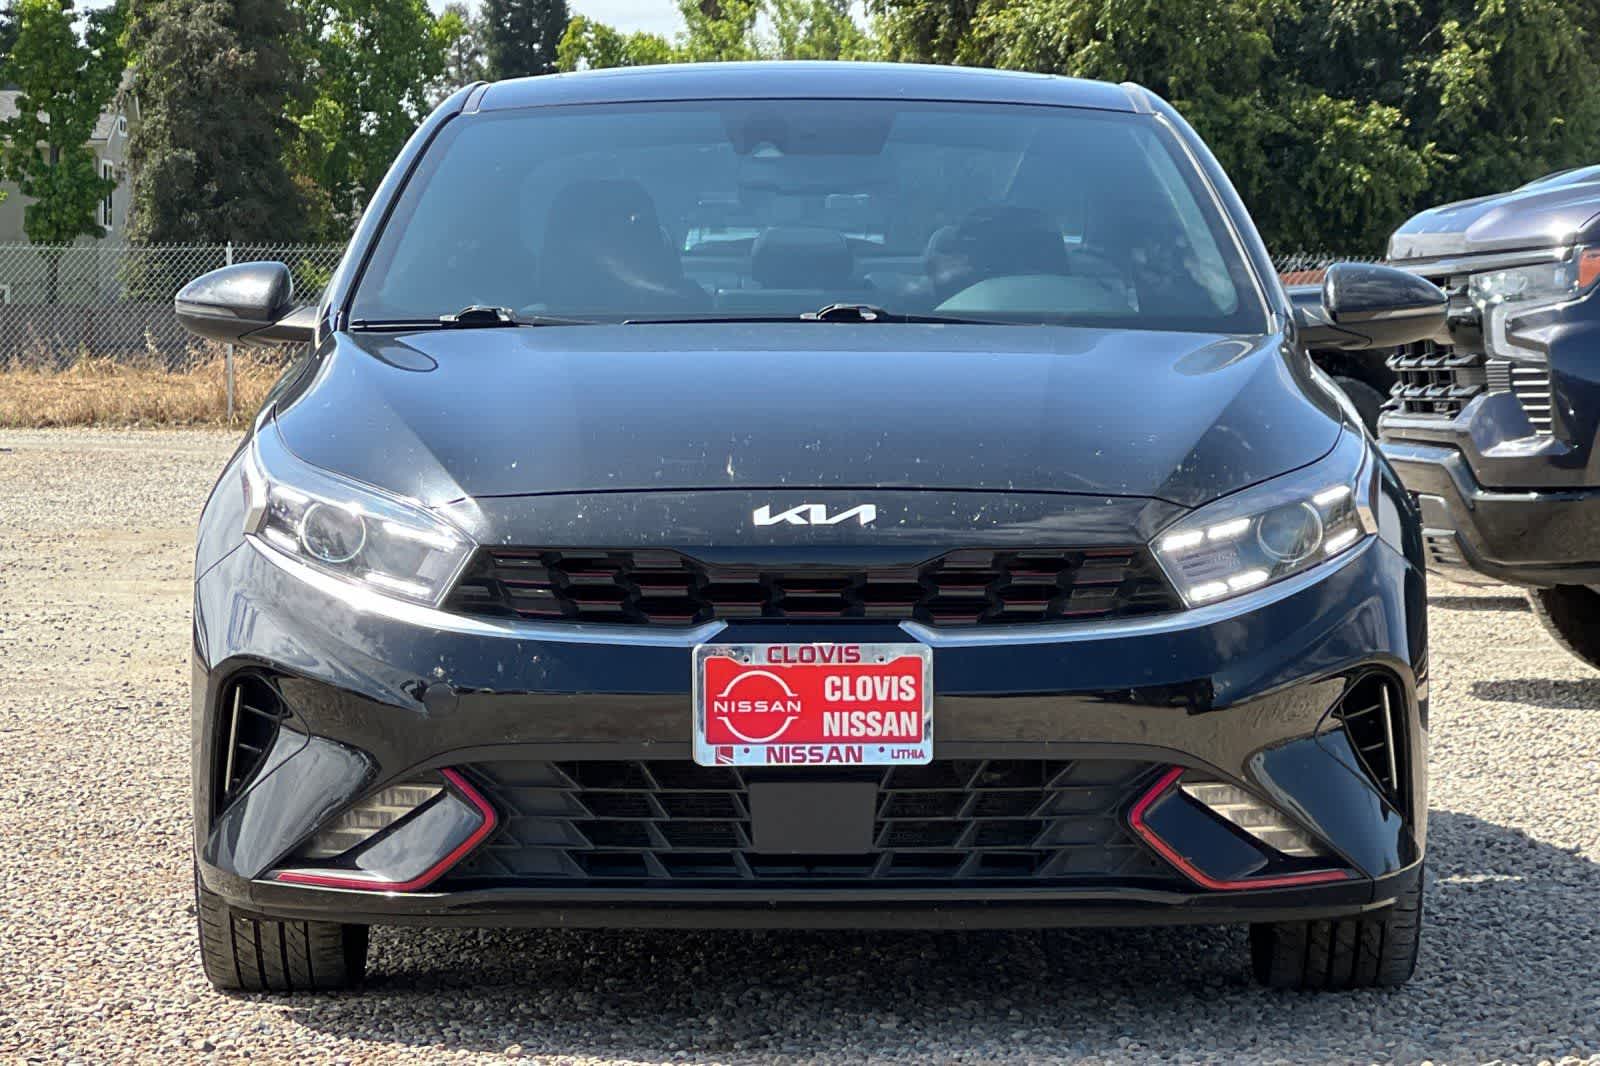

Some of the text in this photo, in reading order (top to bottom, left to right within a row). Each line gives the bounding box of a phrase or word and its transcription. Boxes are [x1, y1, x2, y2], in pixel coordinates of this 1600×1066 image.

[753, 504, 876, 526] KIA
[767, 645, 861, 664] CLOVIS
[824, 675, 917, 702] CLOVIS
[714, 701, 802, 713] NISSAN
[822, 711, 918, 737] NISSAN
[766, 746, 863, 764] NISSAN
[890, 748, 925, 760] LITHIA
